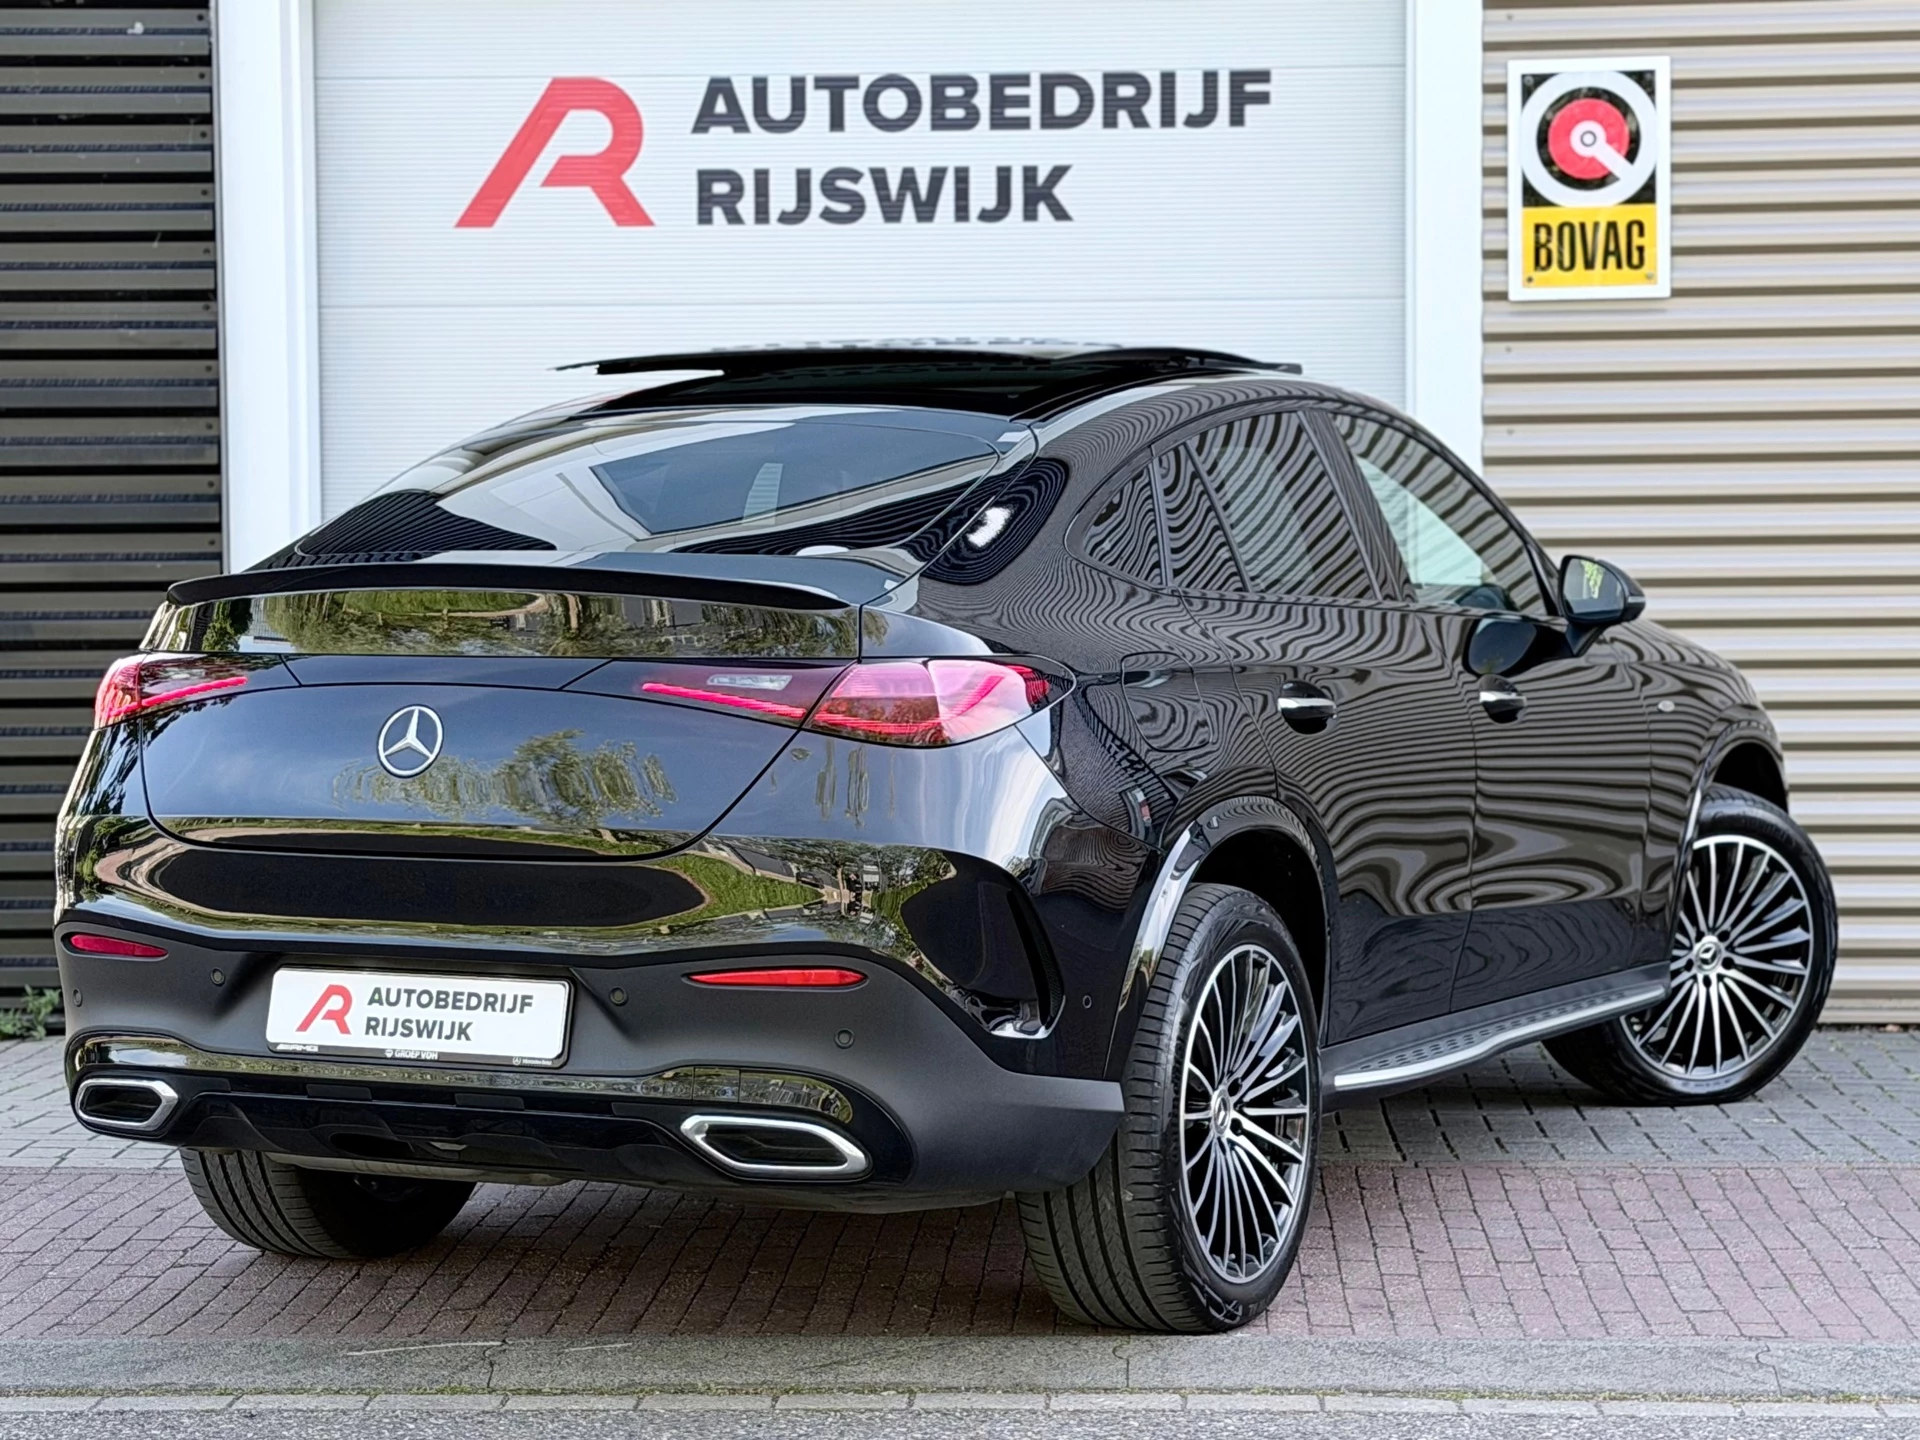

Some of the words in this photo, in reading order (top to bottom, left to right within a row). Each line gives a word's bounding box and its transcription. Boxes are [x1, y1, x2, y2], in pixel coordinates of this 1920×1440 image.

[691, 70, 1271, 134] AUTOBEDRIJF
[697, 165, 1073, 225] RIJSWIJK
[1534, 219, 1646, 272] BOVAG
[367, 986, 534, 1014] AUTOBEDRIJF
[364, 1016, 473, 1041] RIJSWIJK
[394, 1049, 420, 1059] GROEP
[420, 1050, 439, 1060] VDH
